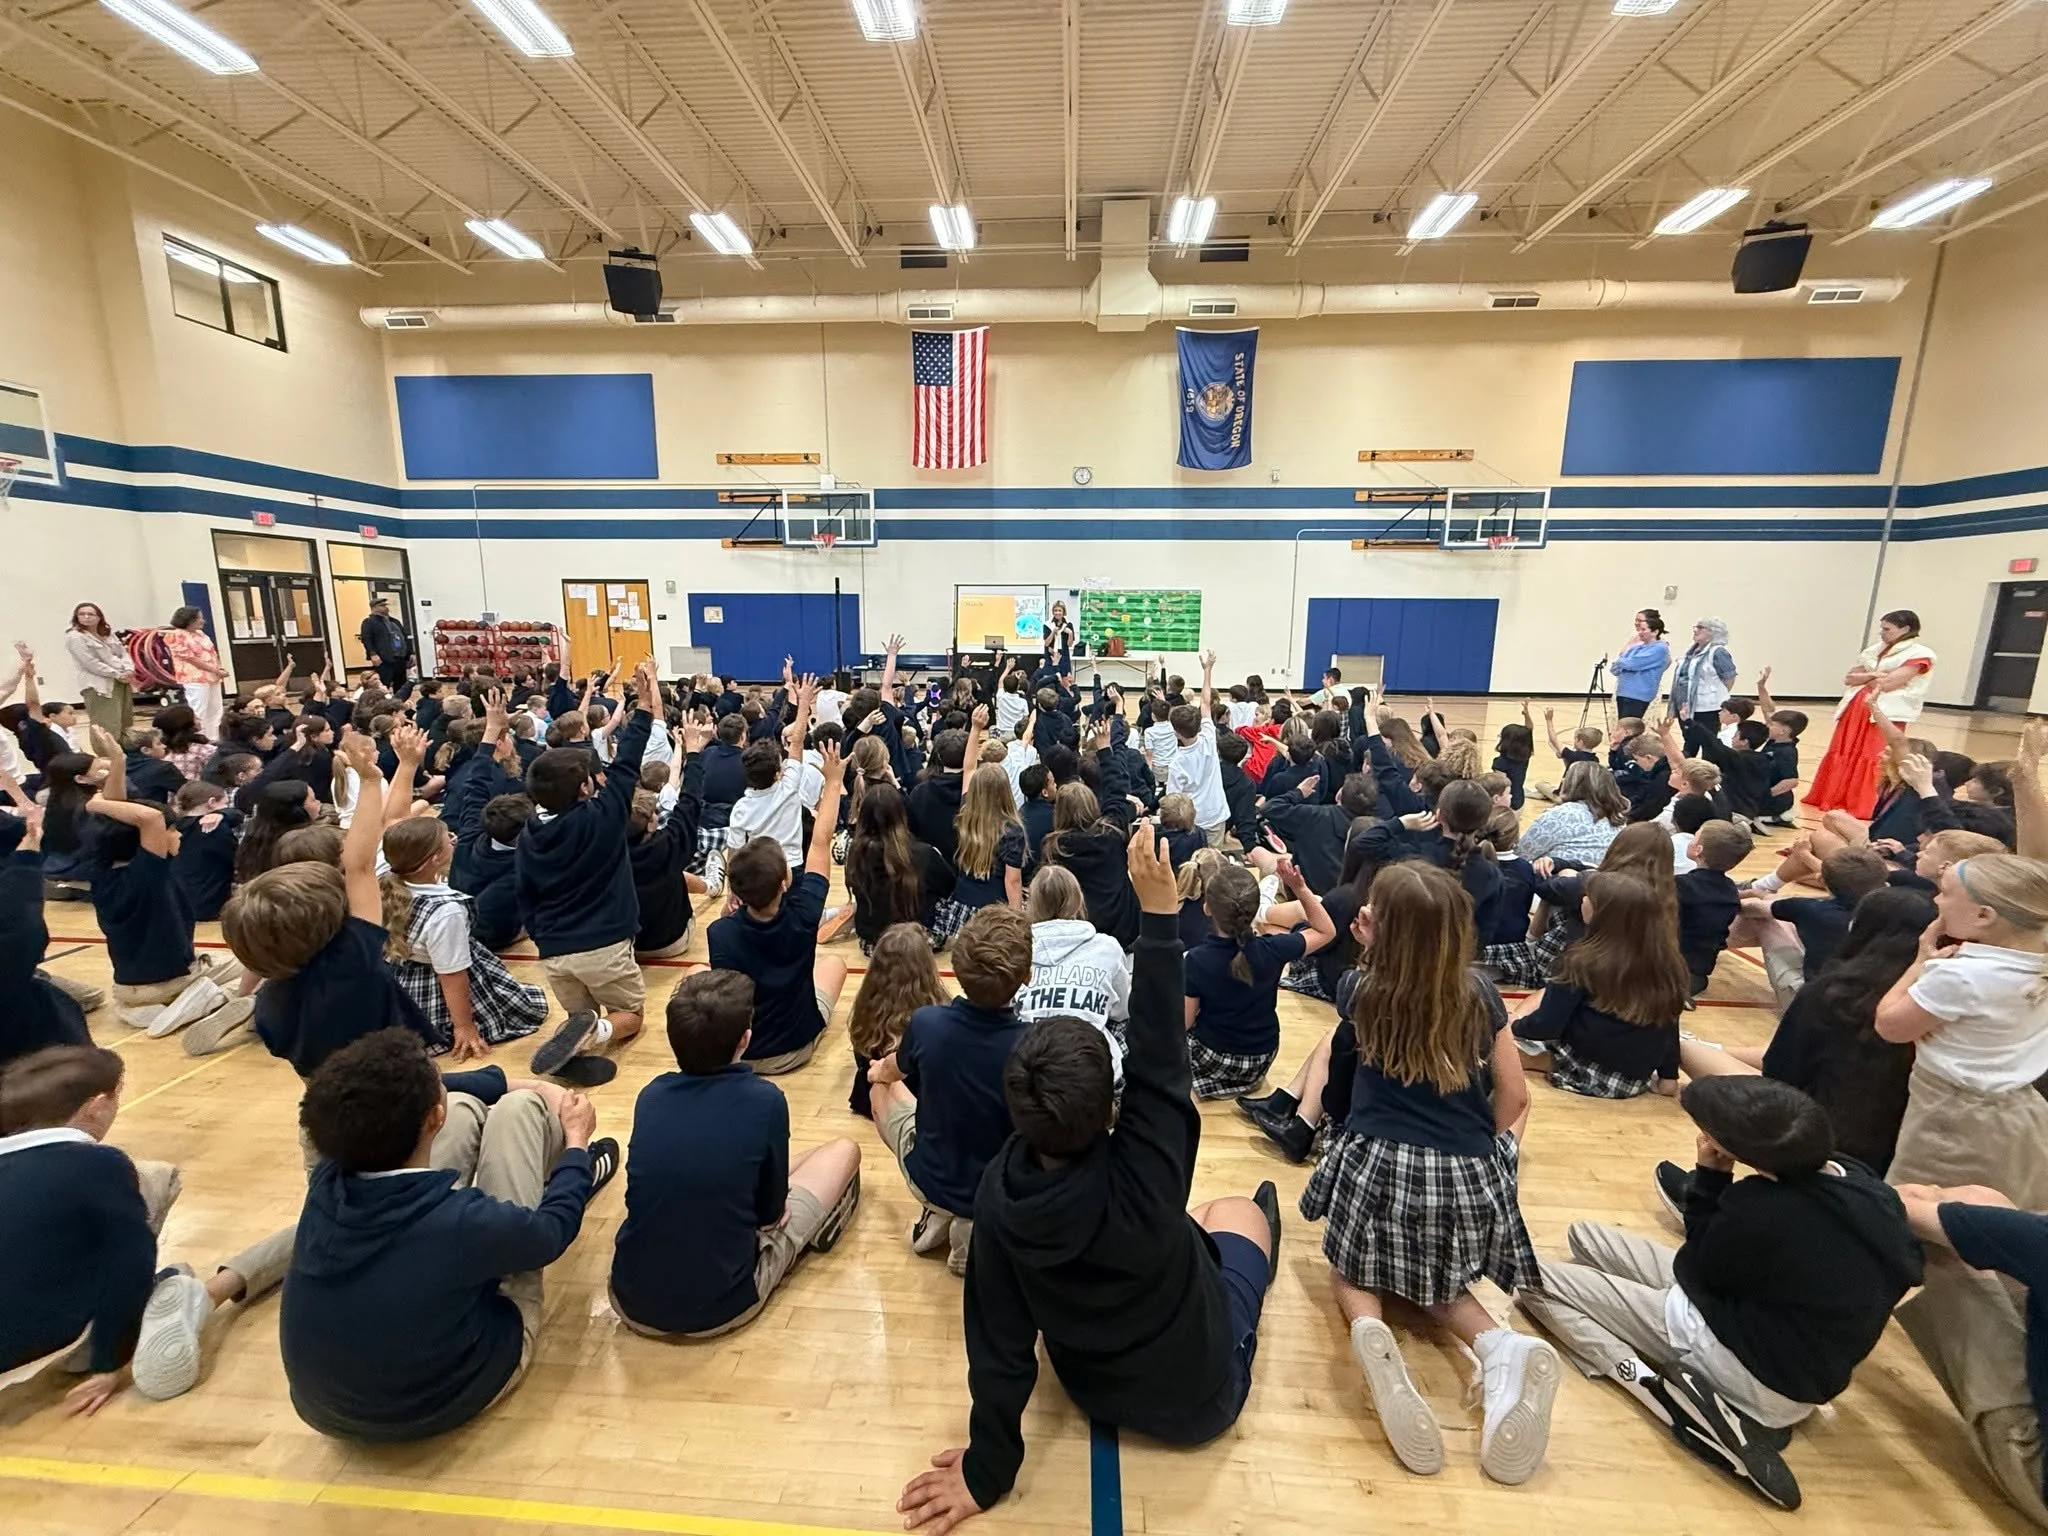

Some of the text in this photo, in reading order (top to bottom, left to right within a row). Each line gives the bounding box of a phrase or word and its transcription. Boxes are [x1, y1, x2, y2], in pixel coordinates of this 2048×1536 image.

[1230, 352, 1246, 448] STATE OF OREGON
[1054, 964, 1107, 990] LADY
[1030, 987, 1067, 1010] THE
[1069, 988, 1109, 1016] LAKE
